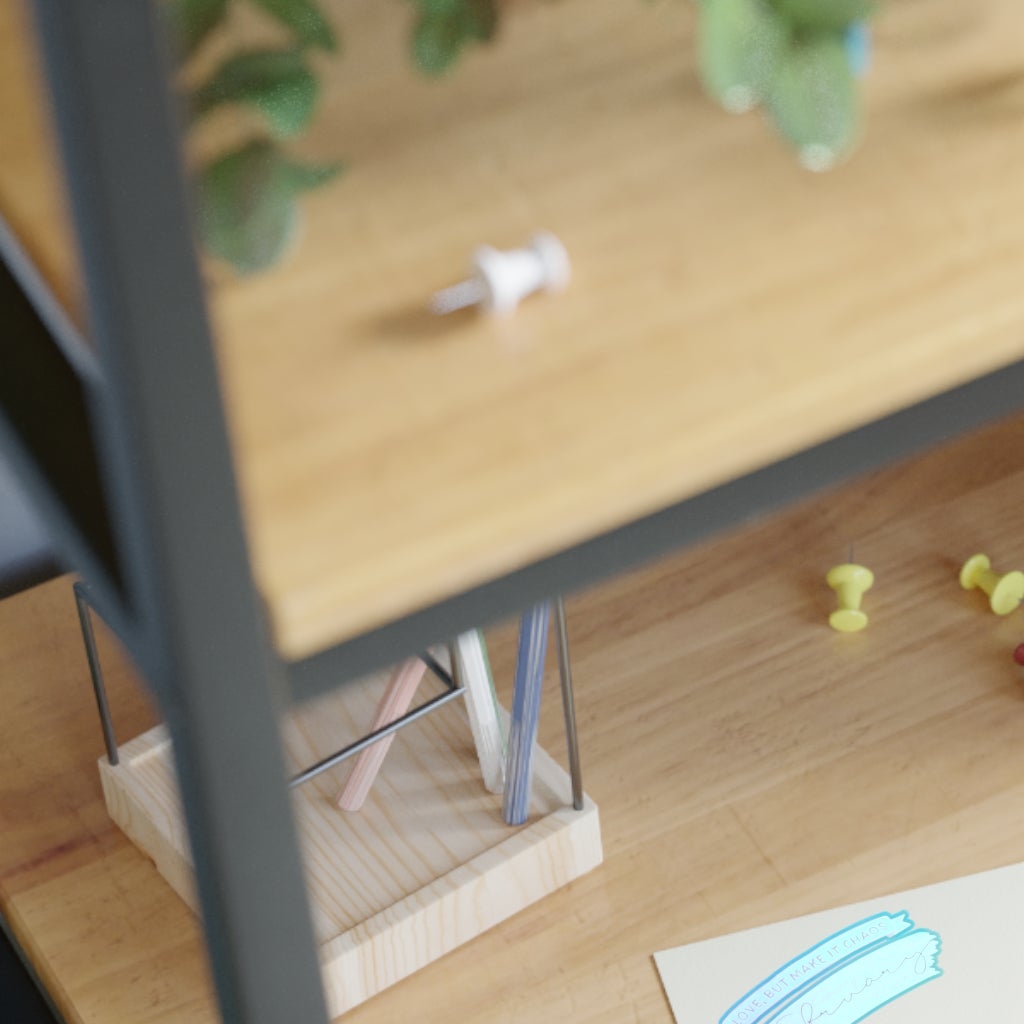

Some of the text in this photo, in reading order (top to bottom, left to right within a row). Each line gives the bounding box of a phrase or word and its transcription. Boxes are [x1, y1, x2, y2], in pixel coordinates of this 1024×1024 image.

[764, 976, 789, 1000] BUT
[789, 955, 826, 980] MAKE
[826, 945, 841, 964] IT
[842, 920, 892, 949] CHAOS
